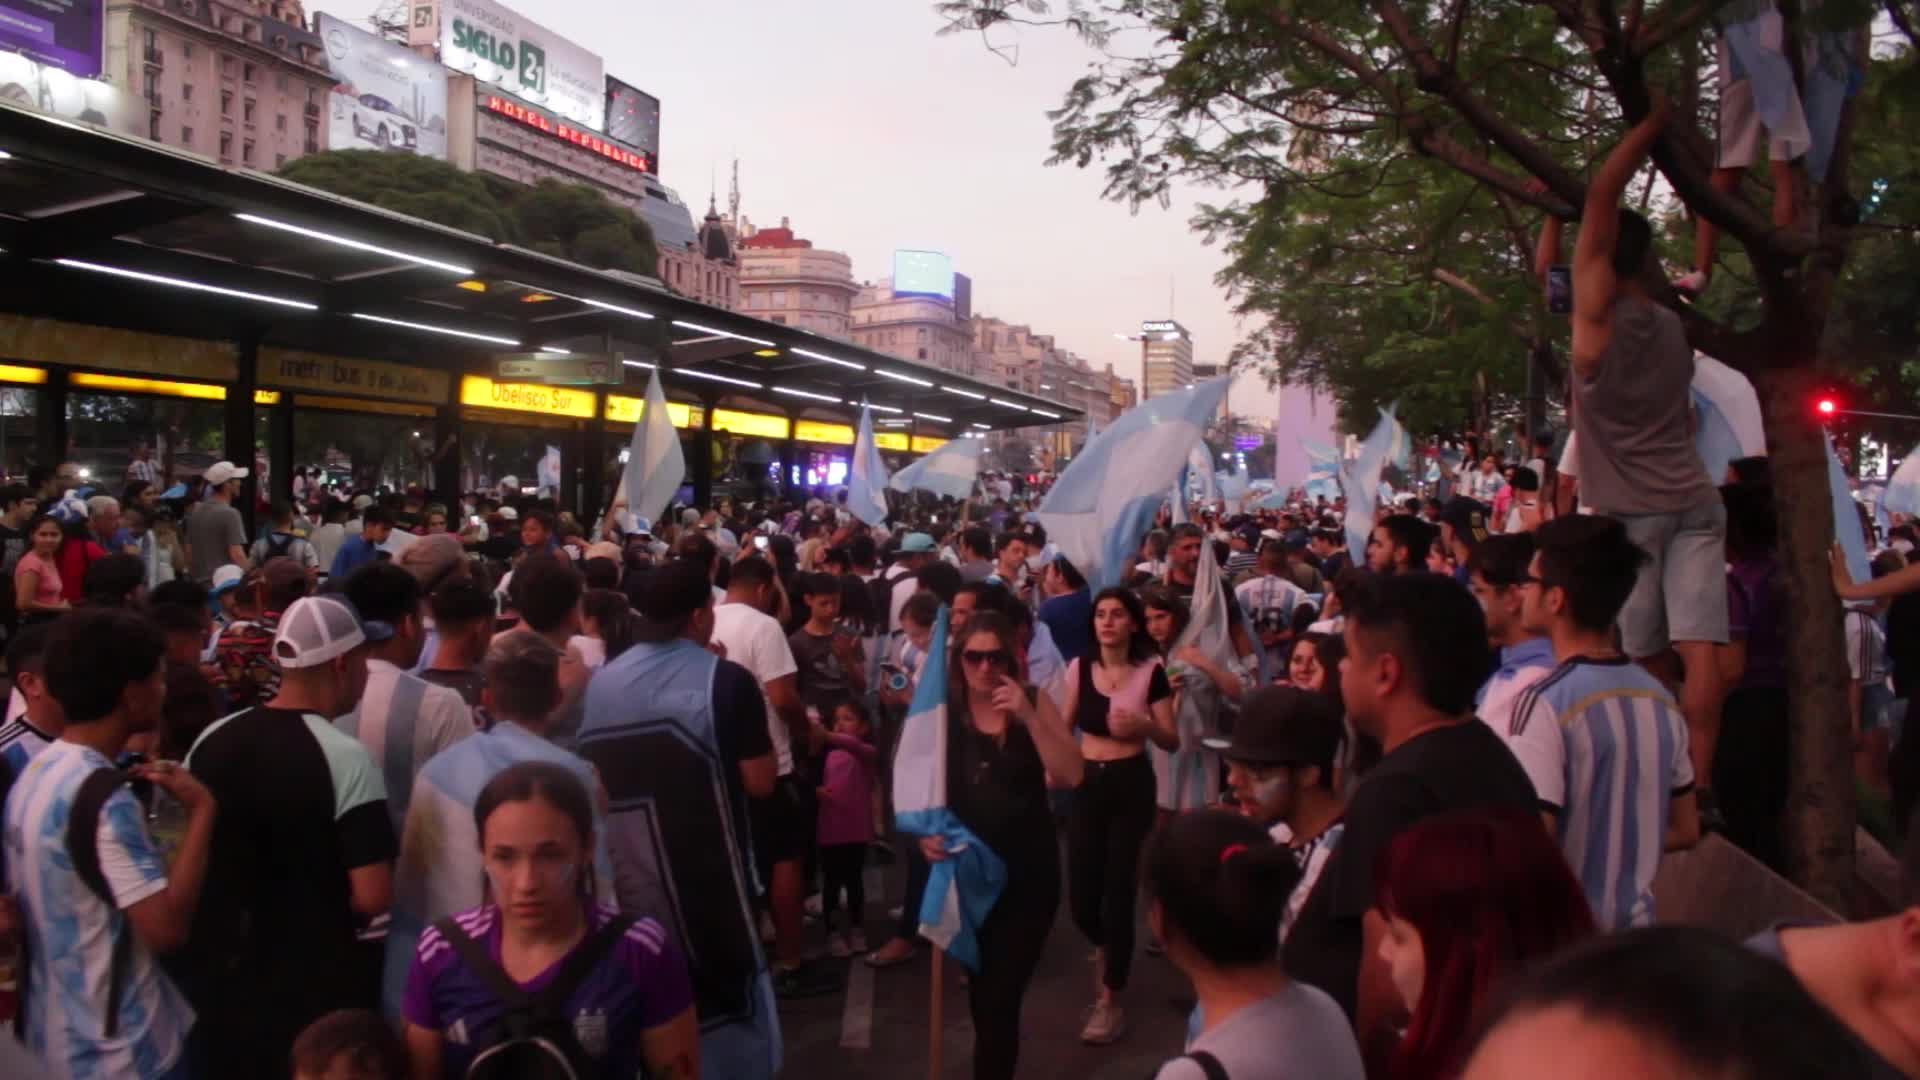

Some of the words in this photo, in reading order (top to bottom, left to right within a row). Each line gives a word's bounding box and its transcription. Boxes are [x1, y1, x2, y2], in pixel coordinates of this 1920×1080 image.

[452, 18, 515, 70] SIGLO
[524, 52, 543, 91] 21
[489, 96, 550, 131] HOTEL
[556, 123, 648, 171] REPUBLICA
[491, 381, 546, 407] Obelisco
[551, 388, 573, 409] Sur
